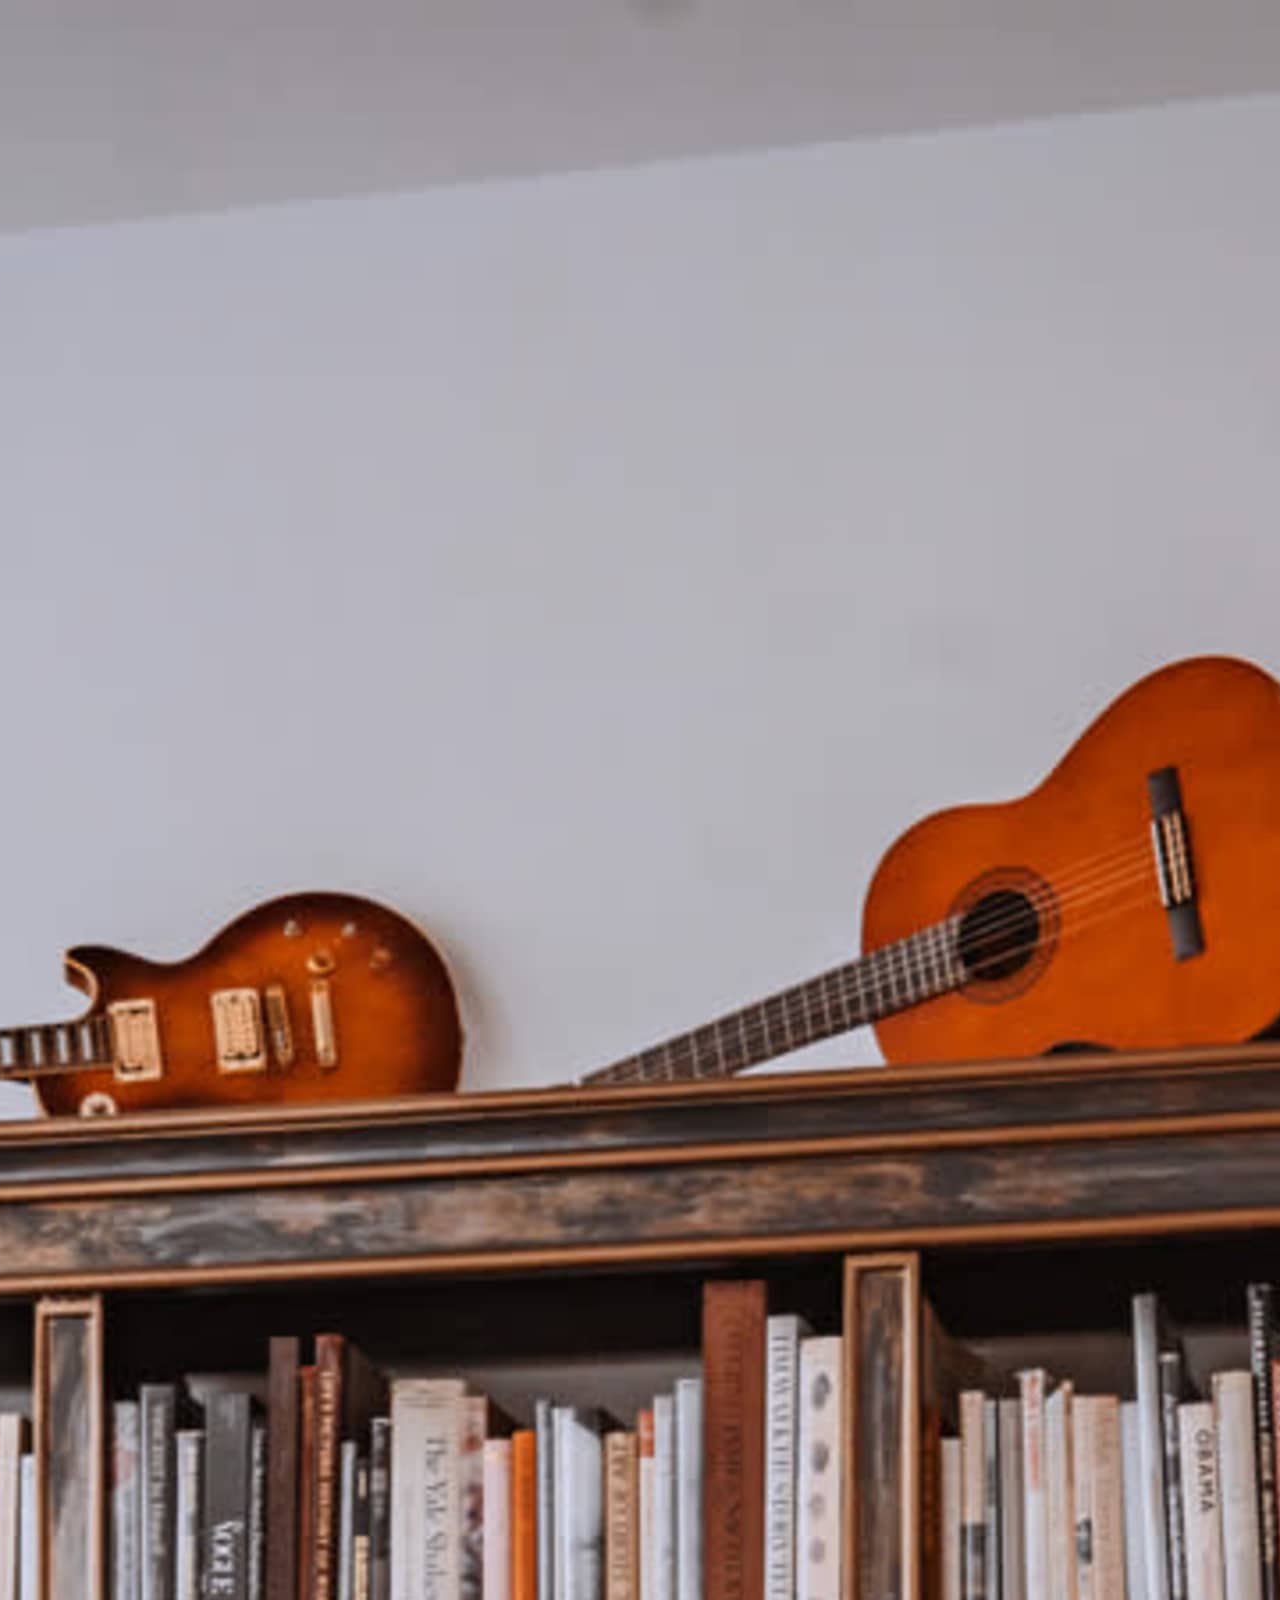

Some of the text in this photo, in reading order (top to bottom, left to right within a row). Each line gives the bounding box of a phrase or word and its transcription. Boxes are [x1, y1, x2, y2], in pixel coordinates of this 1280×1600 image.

[425, 1435, 447, 1476] The
[1194, 1429, 1214, 1513] OBAMA
[425, 1482, 448, 1525] Yale
